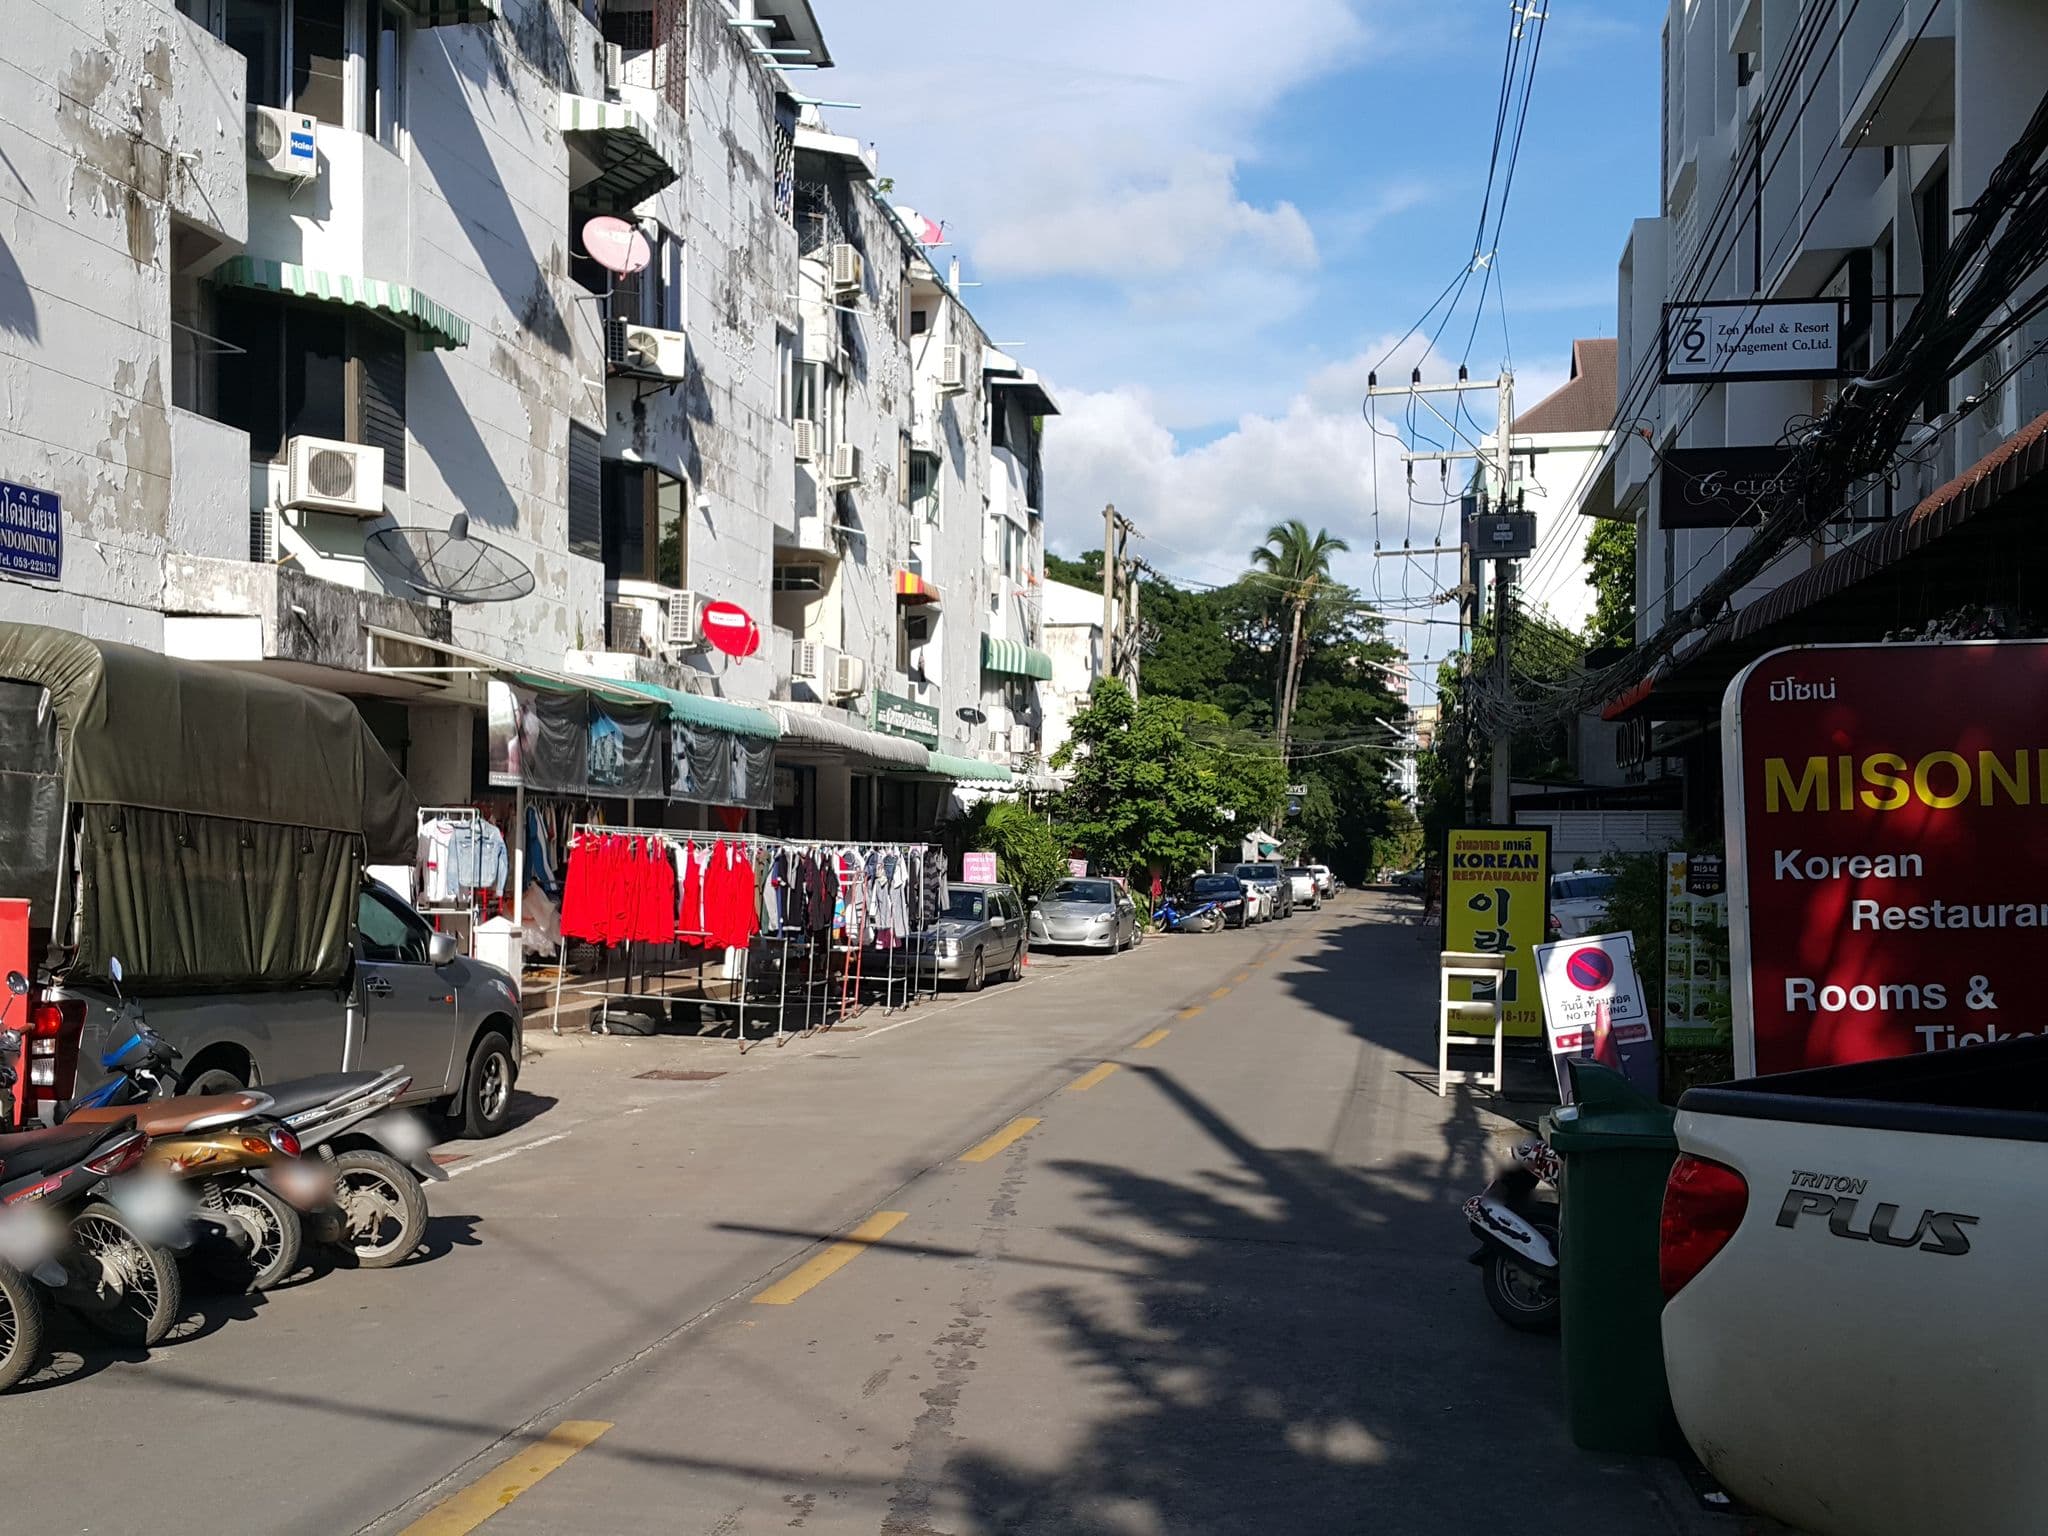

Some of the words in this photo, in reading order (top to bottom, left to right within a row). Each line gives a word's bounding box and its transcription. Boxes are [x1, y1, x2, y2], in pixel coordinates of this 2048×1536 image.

[291, 140, 313, 151] Haier
[1718, 324, 1740, 336] Zen
[1745, 323, 1774, 335] Hotel
[1779, 323, 1790, 334] &
[1794, 322, 1830, 333] Resort
[1716, 342, 1788, 356] Management
[1792, 339, 1832, 351] Co.Ltd.
[0, 528, 57, 558] NDOMINIUM
[1453, 853, 1539, 869] KOREAN
[1774, 849, 1923, 881] Korean
[1452, 870, 1539, 882] RESTAURANT
[1784, 977, 1948, 1012] Rooms
[1965, 974, 1999, 1011] &
[1566, 1012, 1581, 1021] NO
[1584, 1005, 1628, 1018] PAING
[1791, 1169, 1868, 1195] TRITON
[1775, 1188, 1980, 1256] PLUS
